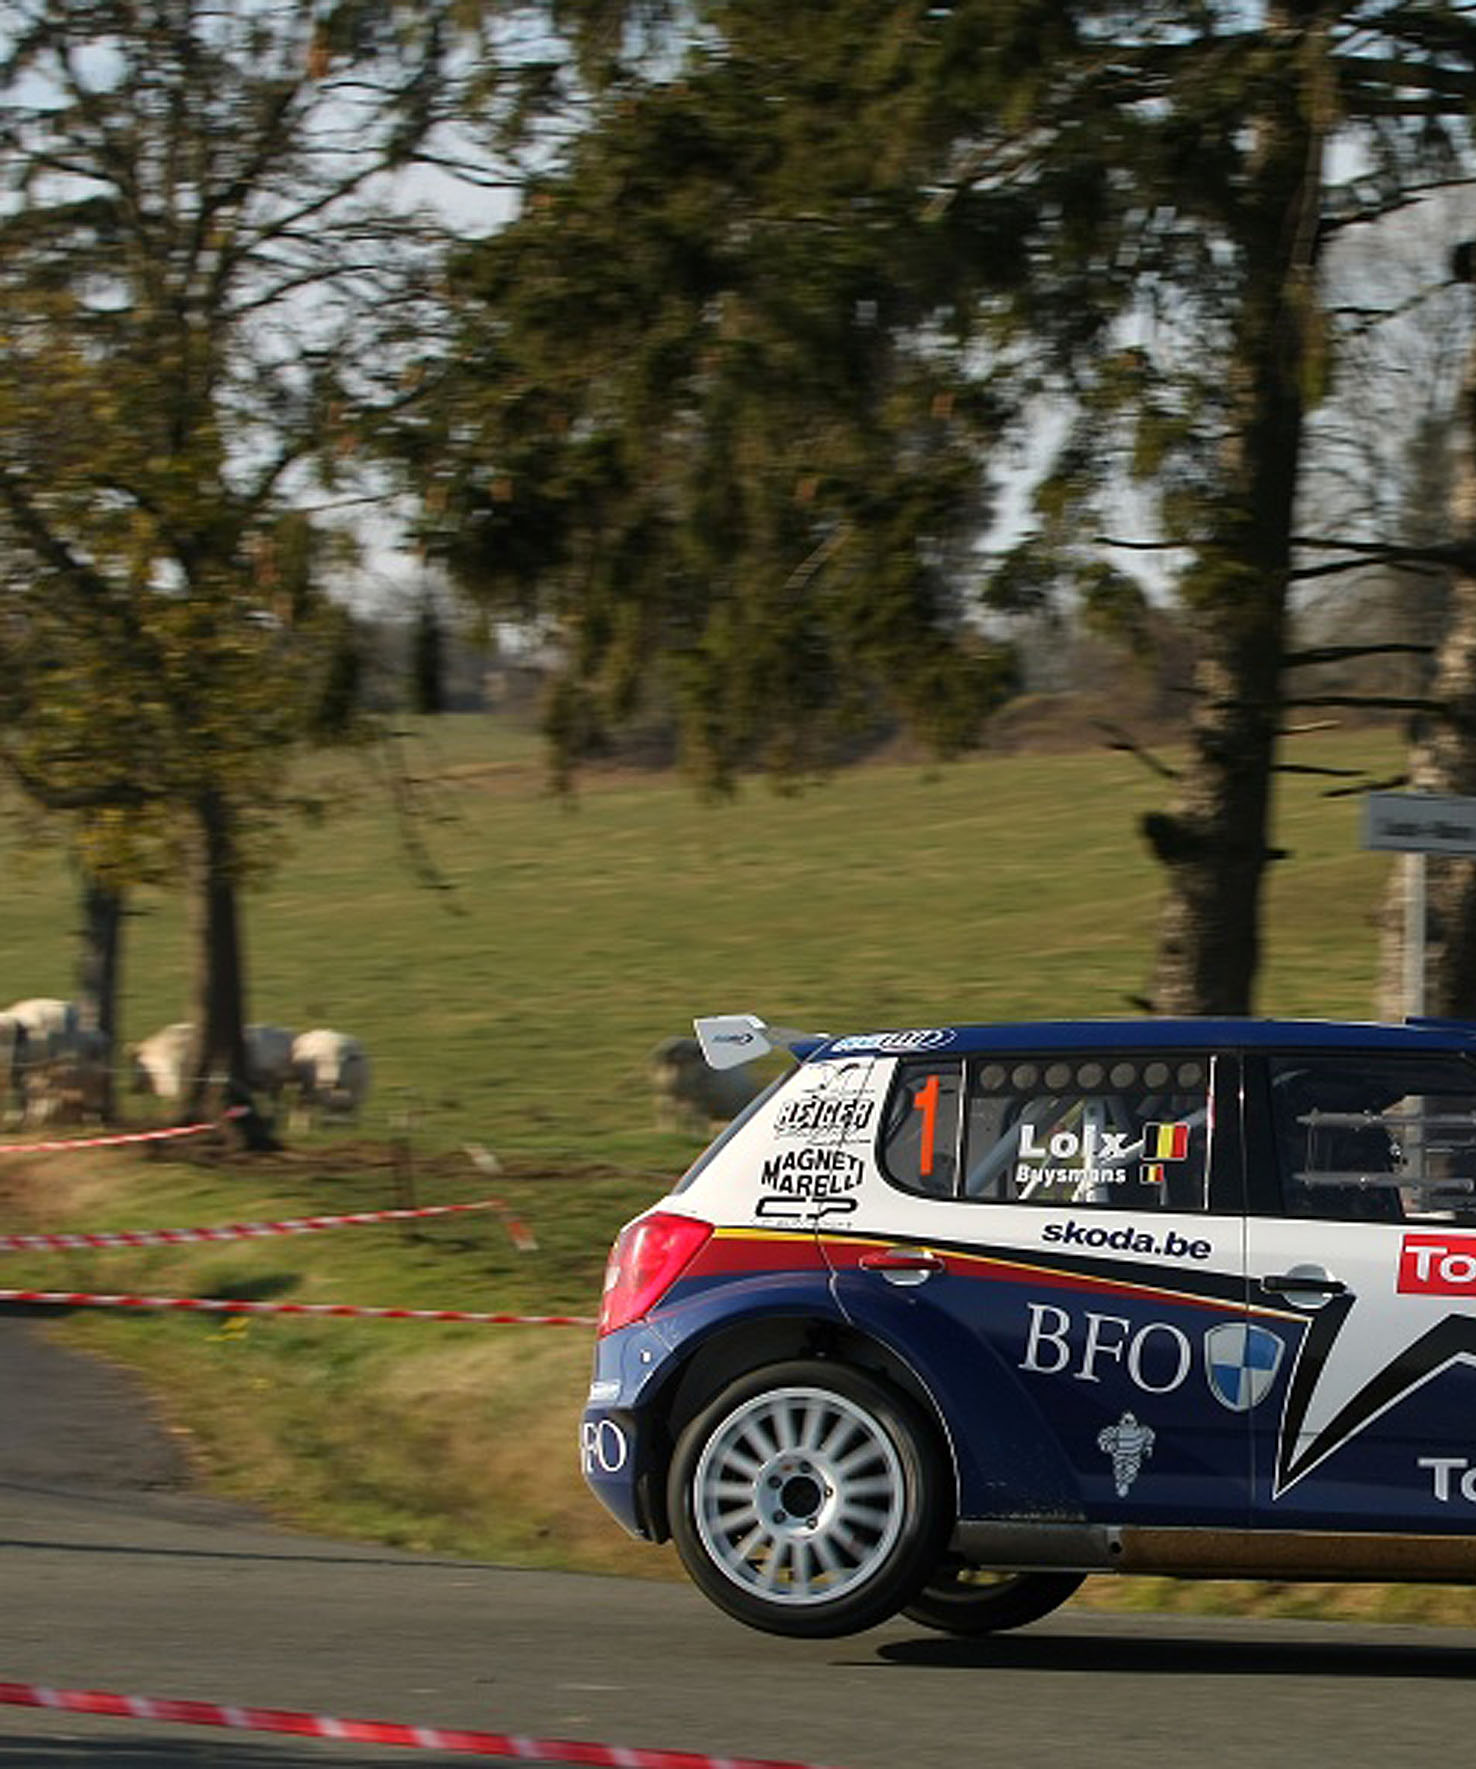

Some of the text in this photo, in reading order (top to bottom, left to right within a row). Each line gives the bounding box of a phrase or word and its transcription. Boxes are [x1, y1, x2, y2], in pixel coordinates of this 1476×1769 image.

[913, 1074, 939, 1176] 1
[1016, 1163, 1126, 1188] Buysmans
[1042, 1222, 1212, 1259] skoda.be
[1018, 1302, 1191, 1393] BFO
